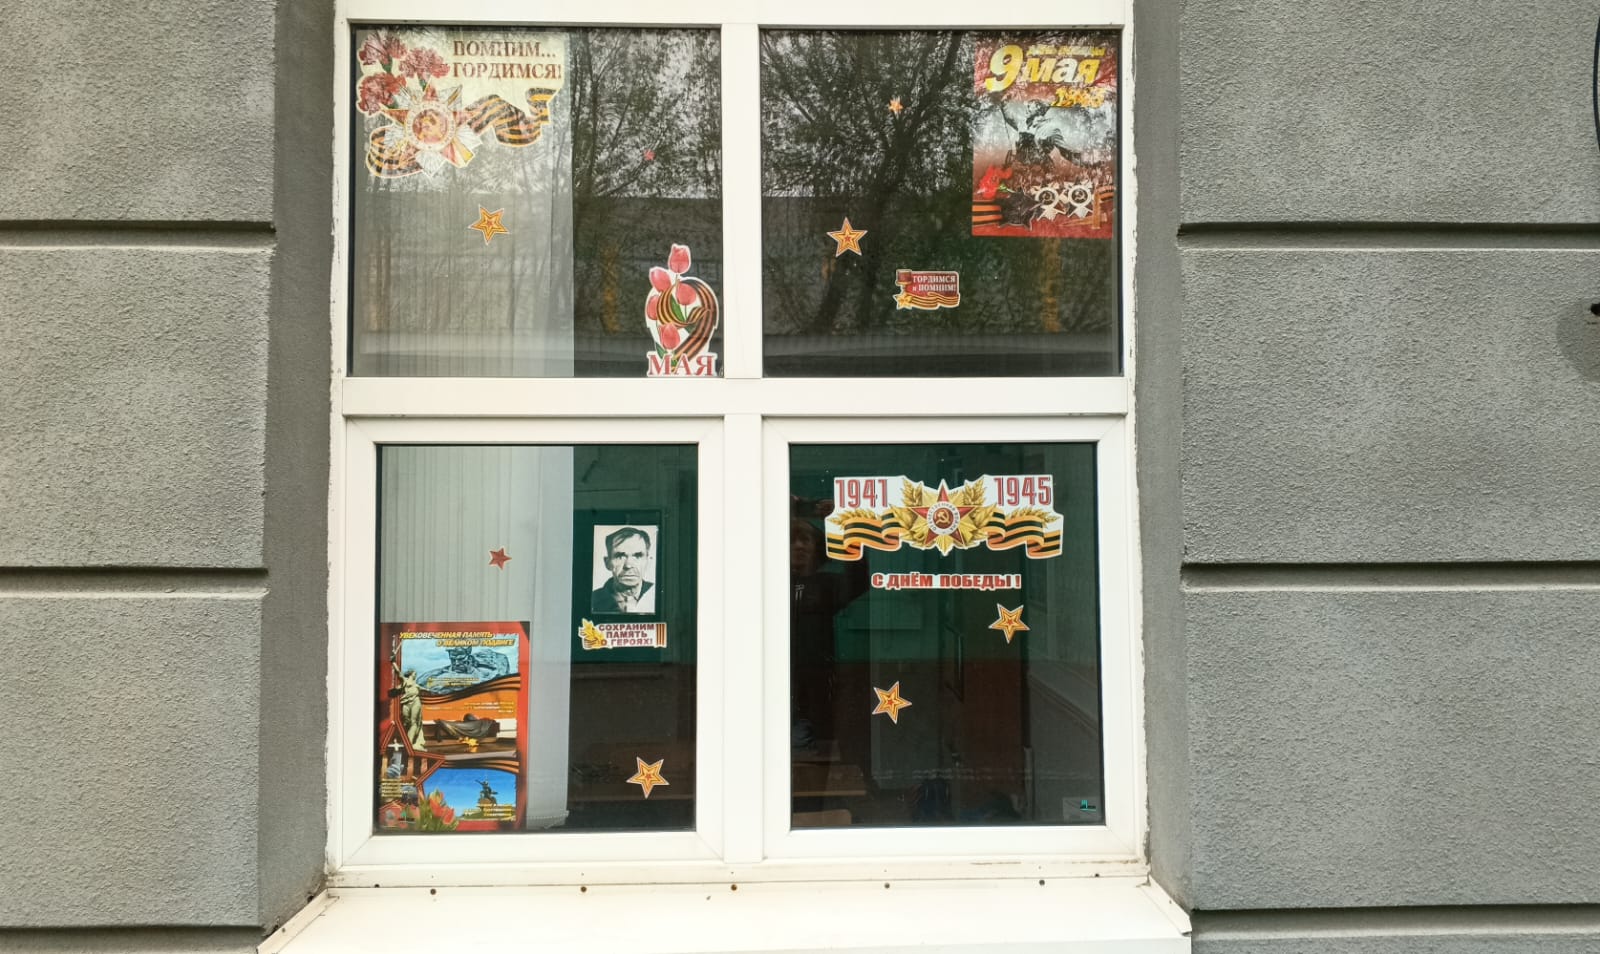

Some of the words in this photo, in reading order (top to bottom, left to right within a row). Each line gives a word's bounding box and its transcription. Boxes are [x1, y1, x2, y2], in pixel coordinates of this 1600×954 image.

[453, 40, 556, 57] ПОМНИМ...
[453, 62, 562, 80] ГОРДИМСЯ!
[984, 44, 1023, 92] 9
[913, 275, 955, 283] ГОРДИМСЯ
[648, 354, 713, 375] МАЯ
[835, 479, 888, 508] 1941
[994, 476, 1052, 507] 1945
[872, 574, 883, 588] С
[887, 572, 933, 590] ДНЁМ
[599, 623, 655, 631] СОХРАНИМ
[611, 638, 653, 646] ГЕРОЯХ!
